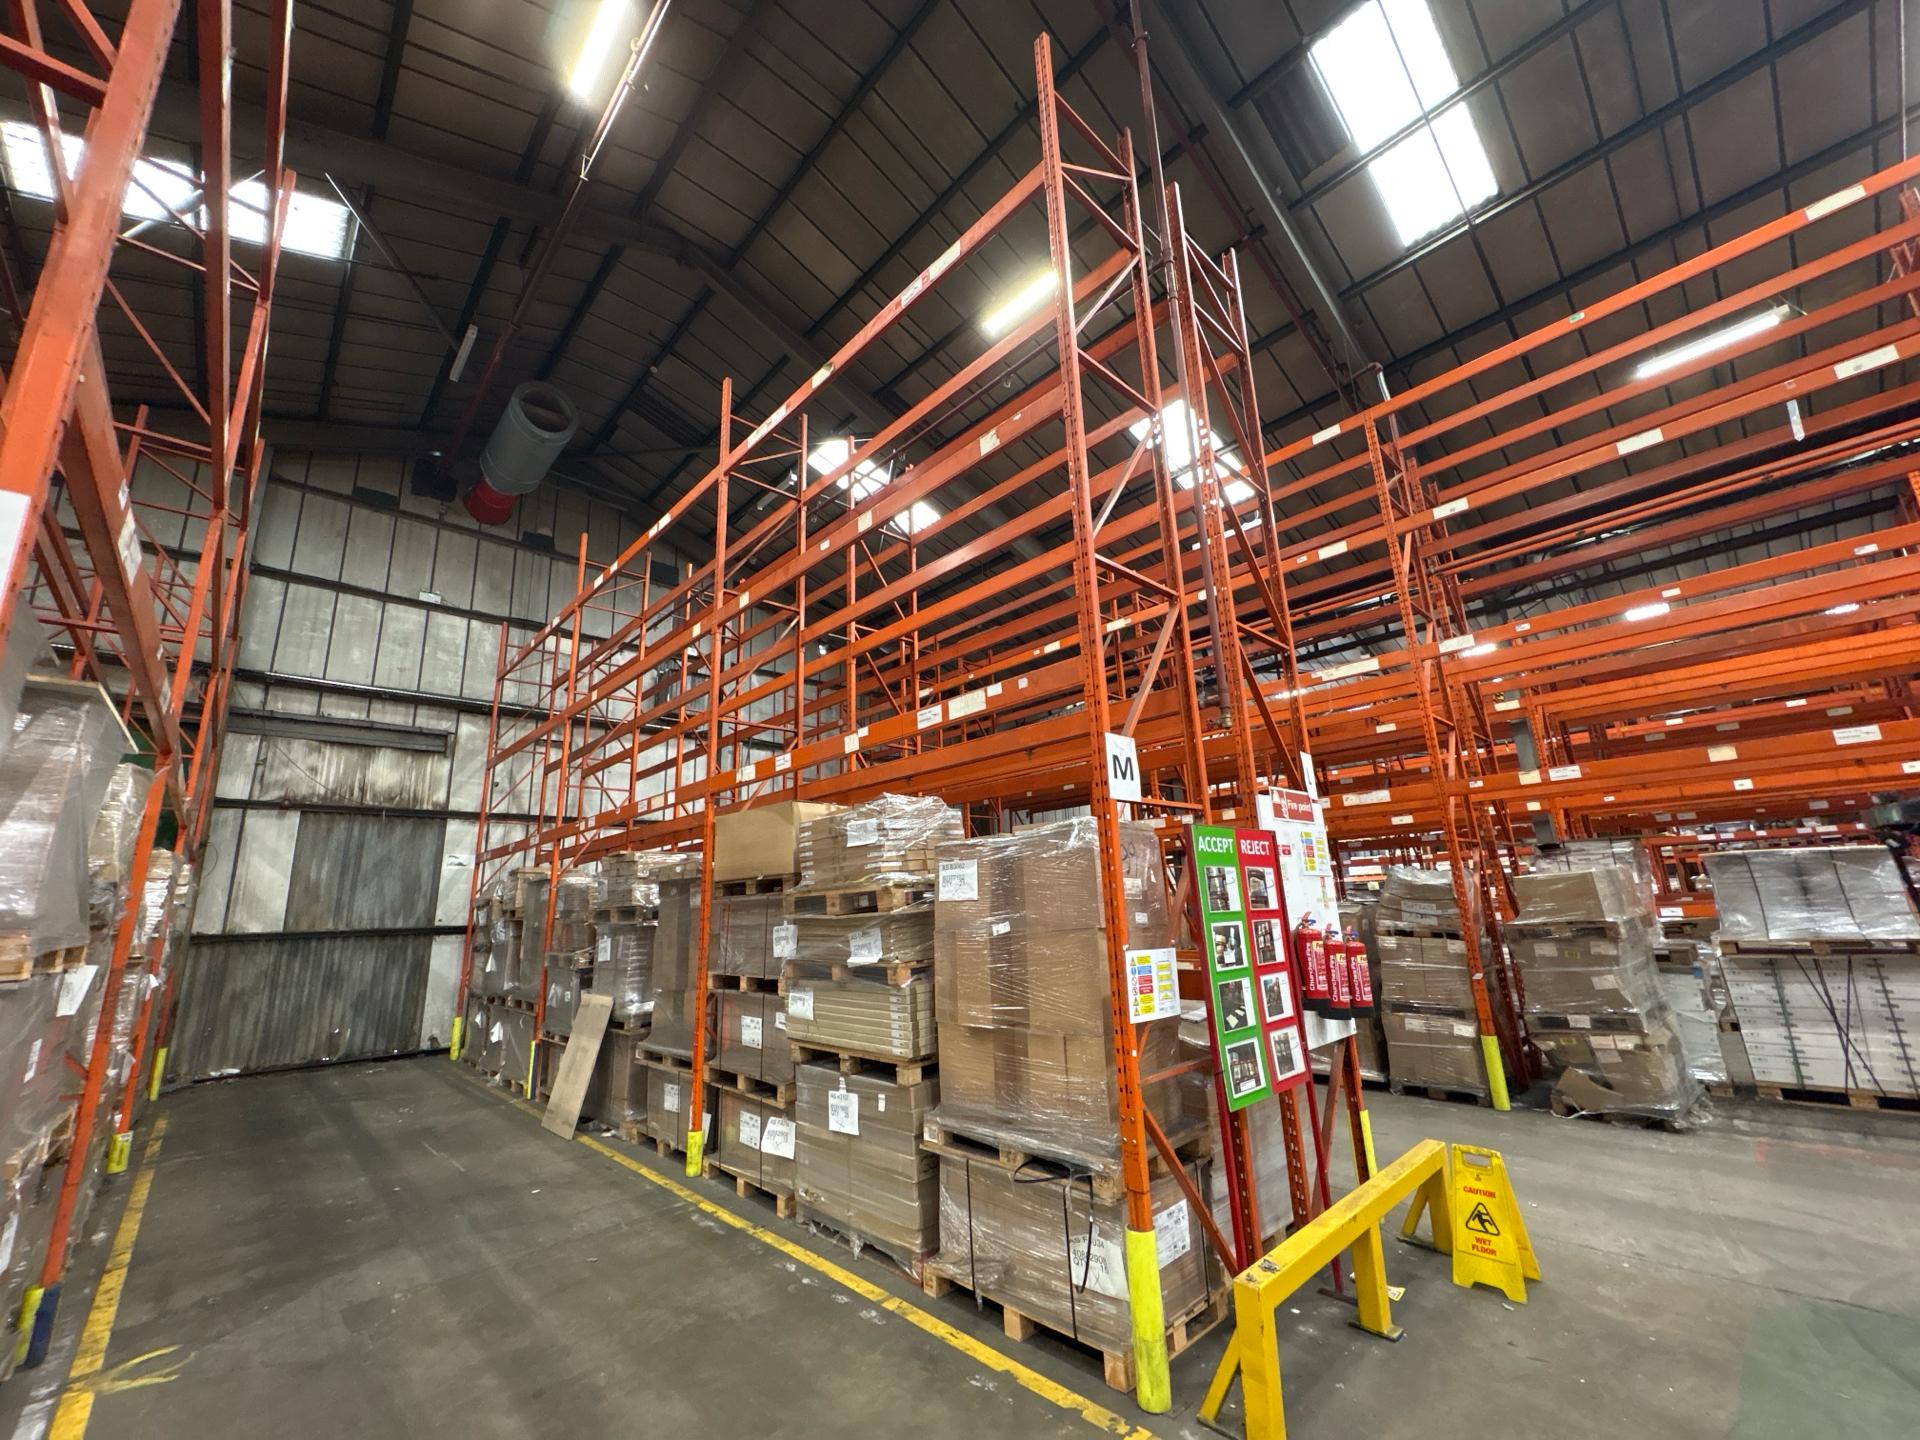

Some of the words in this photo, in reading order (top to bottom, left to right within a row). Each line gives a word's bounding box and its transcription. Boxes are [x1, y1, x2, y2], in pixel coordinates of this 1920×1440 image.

[1112, 754, 1134, 781] M
[1287, 799, 1298, 812] Fire
[1298, 802, 1312, 814] point
[1198, 835, 1234, 854] ACCEPT
[1240, 839, 1270, 856] REJECT
[1463, 1186, 1496, 1198] CAUTION
[1475, 1237, 1491, 1246] WET
[1472, 1244, 1496, 1255] FLOOR
